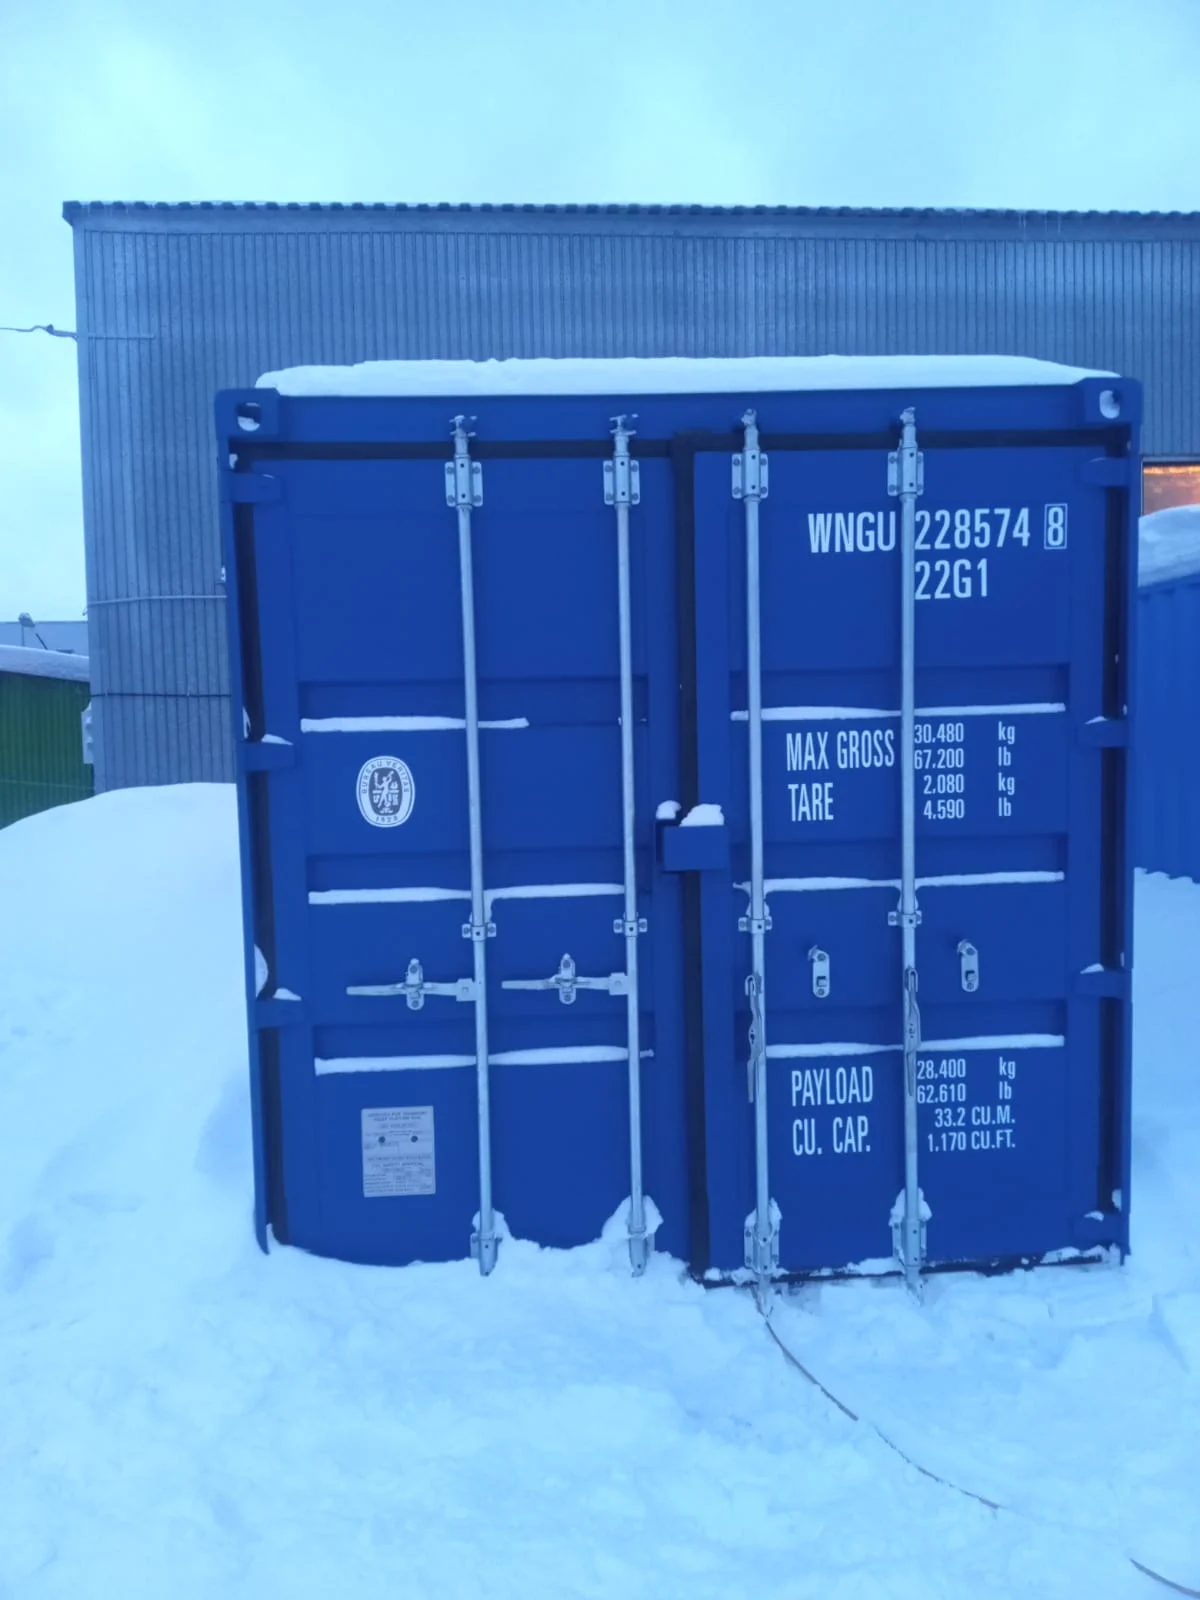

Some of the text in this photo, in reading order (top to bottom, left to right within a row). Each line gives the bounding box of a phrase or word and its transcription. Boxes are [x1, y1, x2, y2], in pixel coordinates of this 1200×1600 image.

[808, 507, 1064, 553] WNGU 228574 8
[914, 558, 988, 600] 22G1
[786, 731, 829, 771] MAX
[837, 729, 895, 769] GROSS
[998, 721, 1016, 744] kg
[998, 747, 1012, 766] lb
[361, 760, 410, 794] BUREAU VERITAS
[788, 782, 834, 822] TARE
[998, 772, 1016, 795] kg
[998, 797, 1012, 817] lb
[791, 1066, 873, 1106] PAYLOAD
[999, 1056, 1016, 1079] kg
[999, 1081, 1012, 1100] lb
[792, 1105, 1016, 1156] CU. CAP. 33.2 CU.M.
[971, 1129, 1016, 1150] CU.FT.
